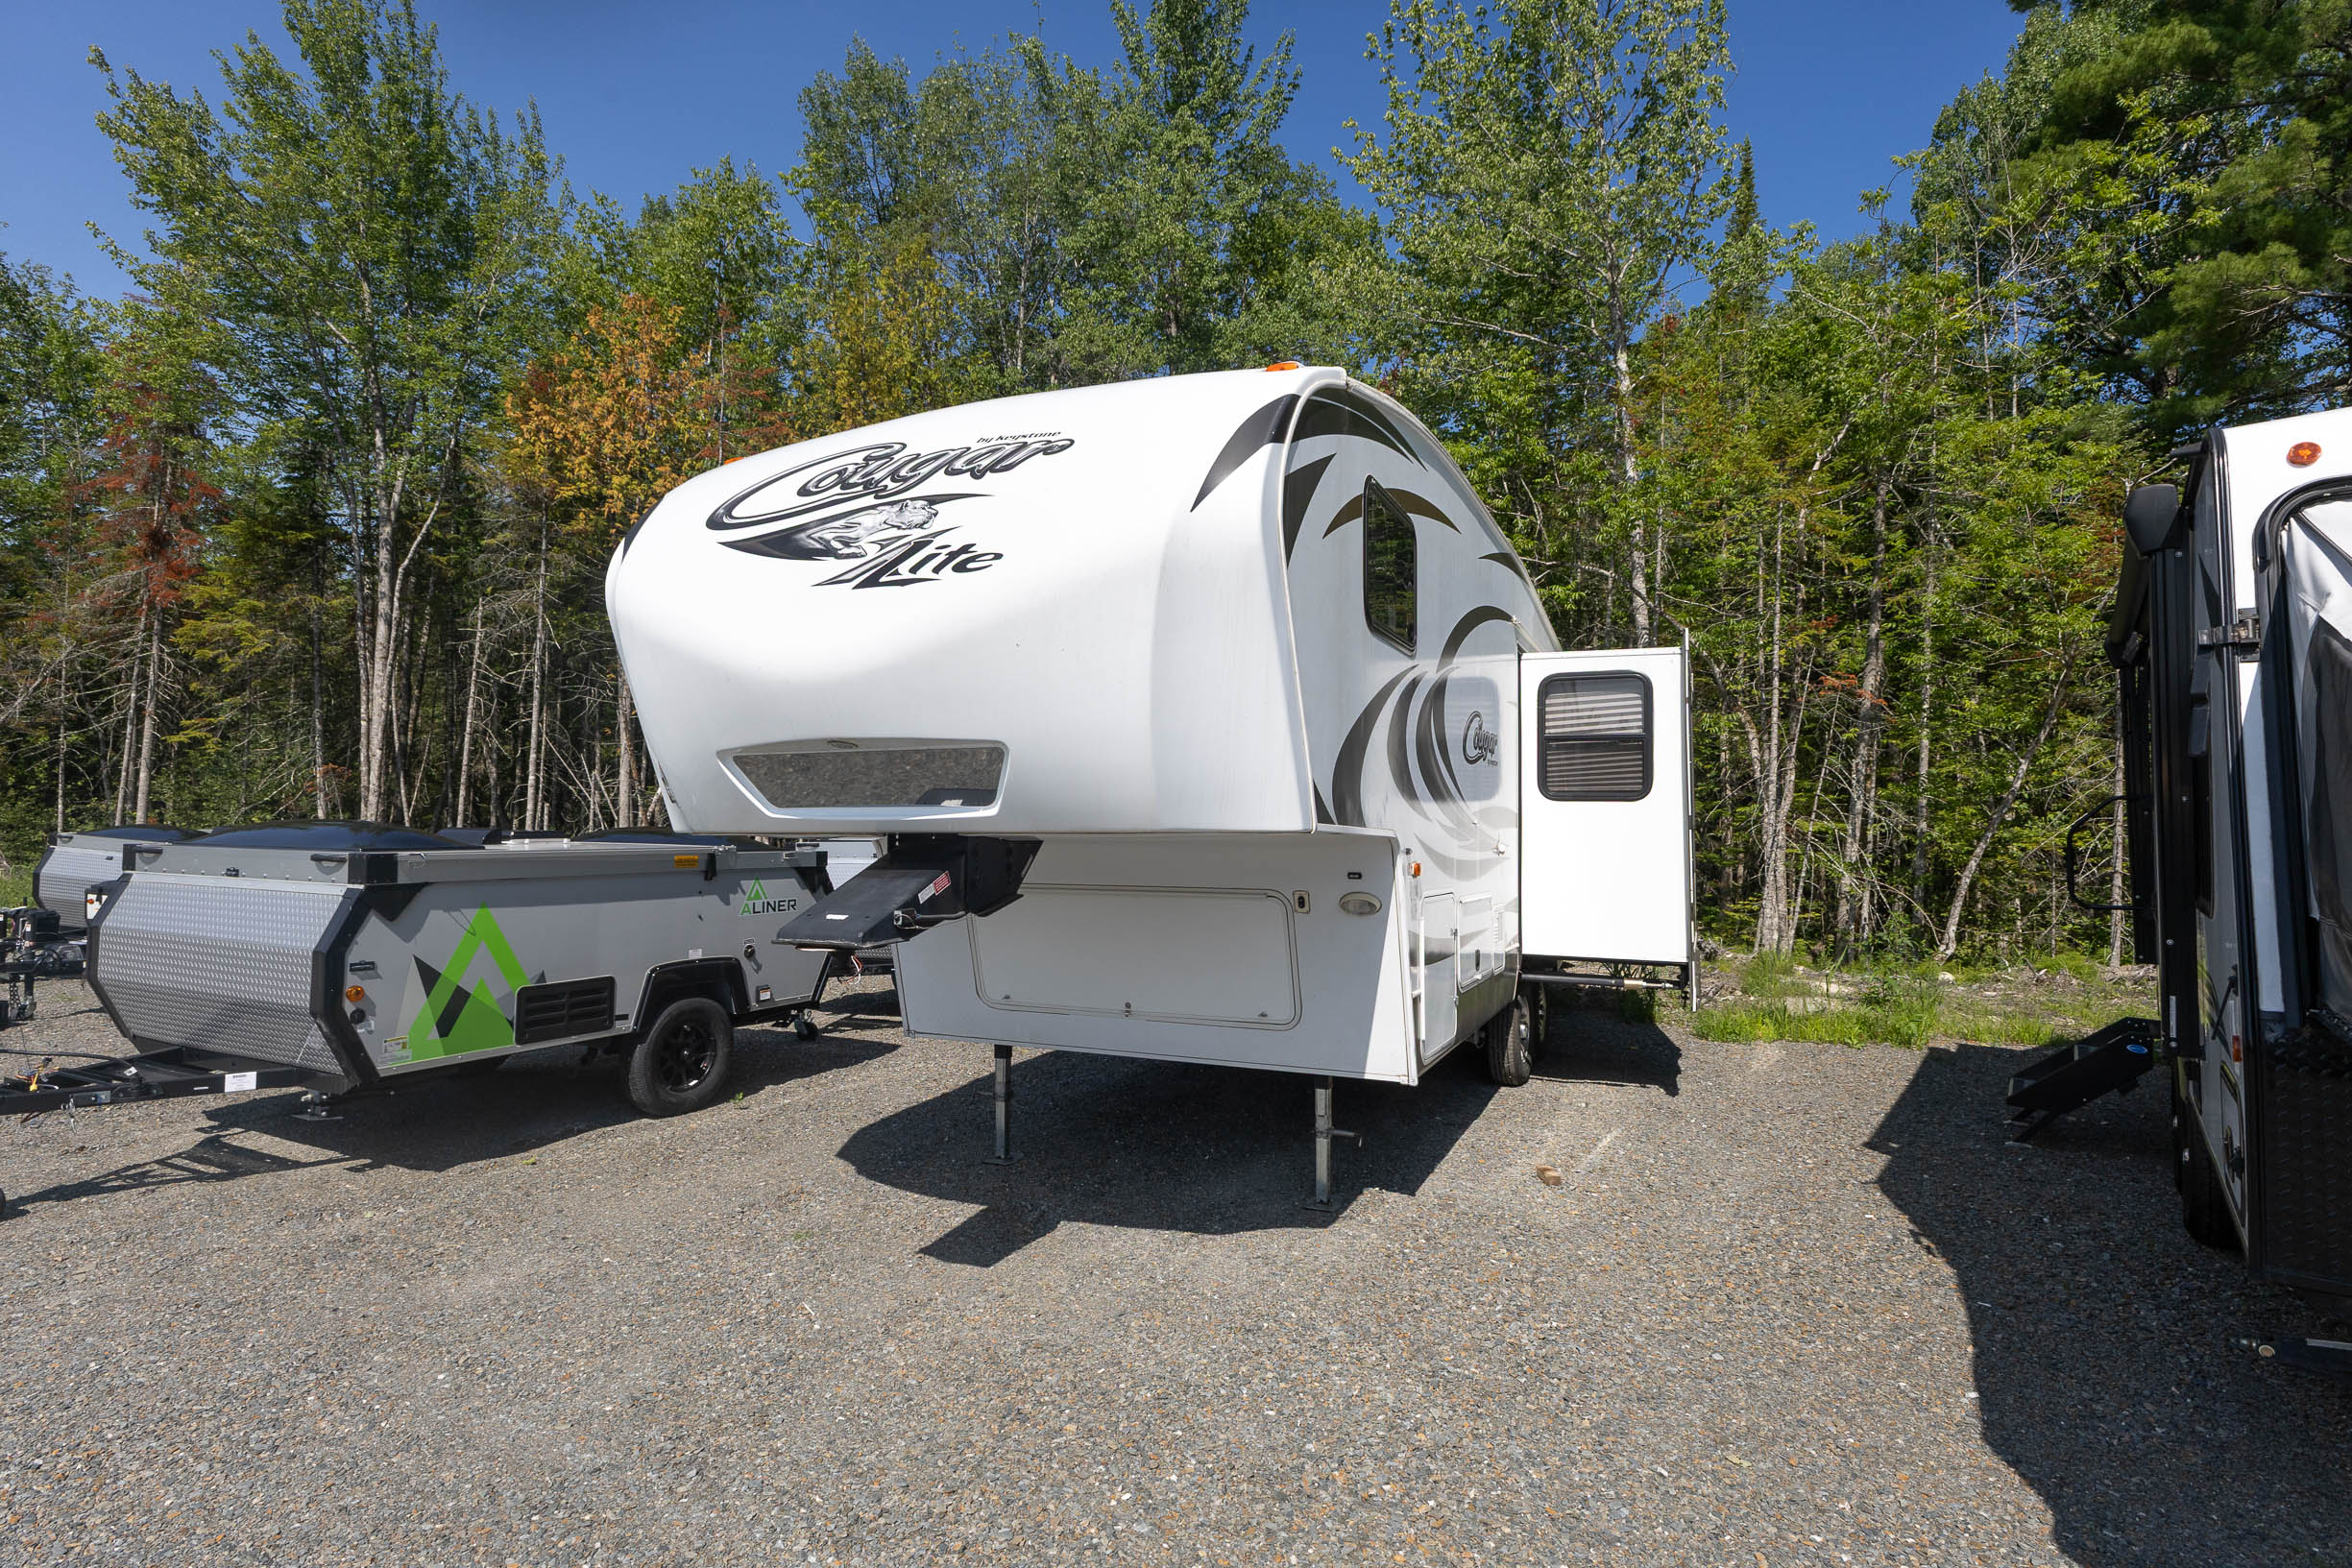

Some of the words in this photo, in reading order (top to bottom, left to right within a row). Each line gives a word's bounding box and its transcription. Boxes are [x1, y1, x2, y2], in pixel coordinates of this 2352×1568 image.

[706, 439, 1075, 531] Cougar
[845, 533, 1004, 590] Lite
[1463, 711, 1498, 764] Cougar
[740, 899, 797, 915] ALINER
